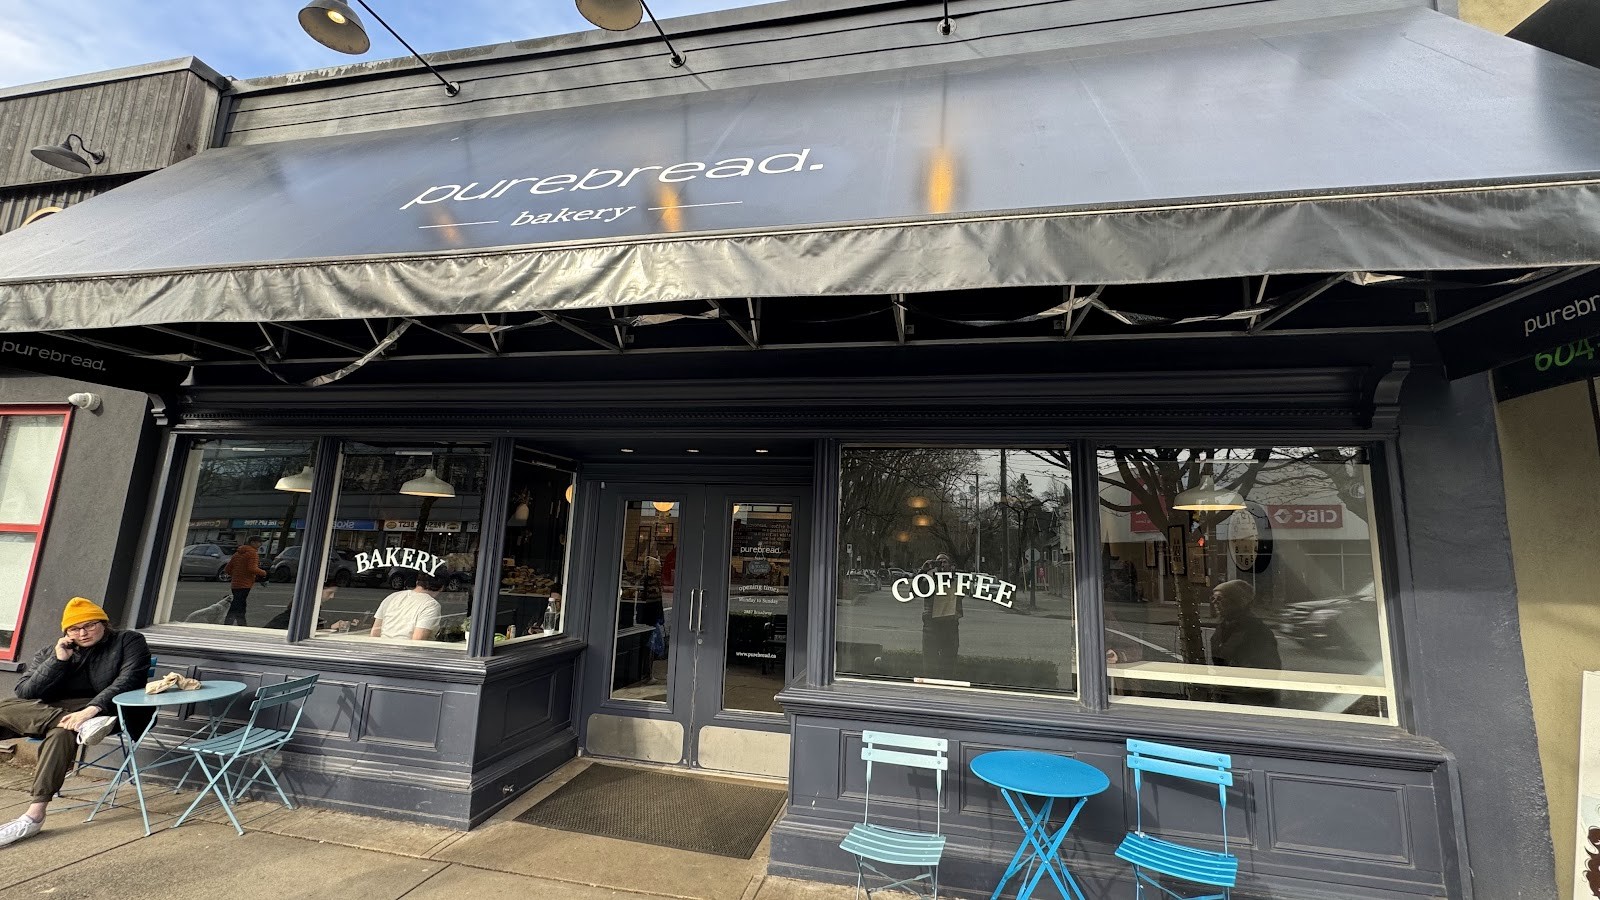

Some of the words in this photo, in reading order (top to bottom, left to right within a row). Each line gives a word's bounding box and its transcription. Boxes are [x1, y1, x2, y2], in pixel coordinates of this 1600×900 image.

[399, 148, 824, 210] purebread.
[511, 205, 636, 226] bakery
[1, 340, 107, 371] purebread.
[354, 547, 446, 578] BAKERY
[738, 583, 763, 593] opening
[891, 571, 1017, 608] COFFEE
